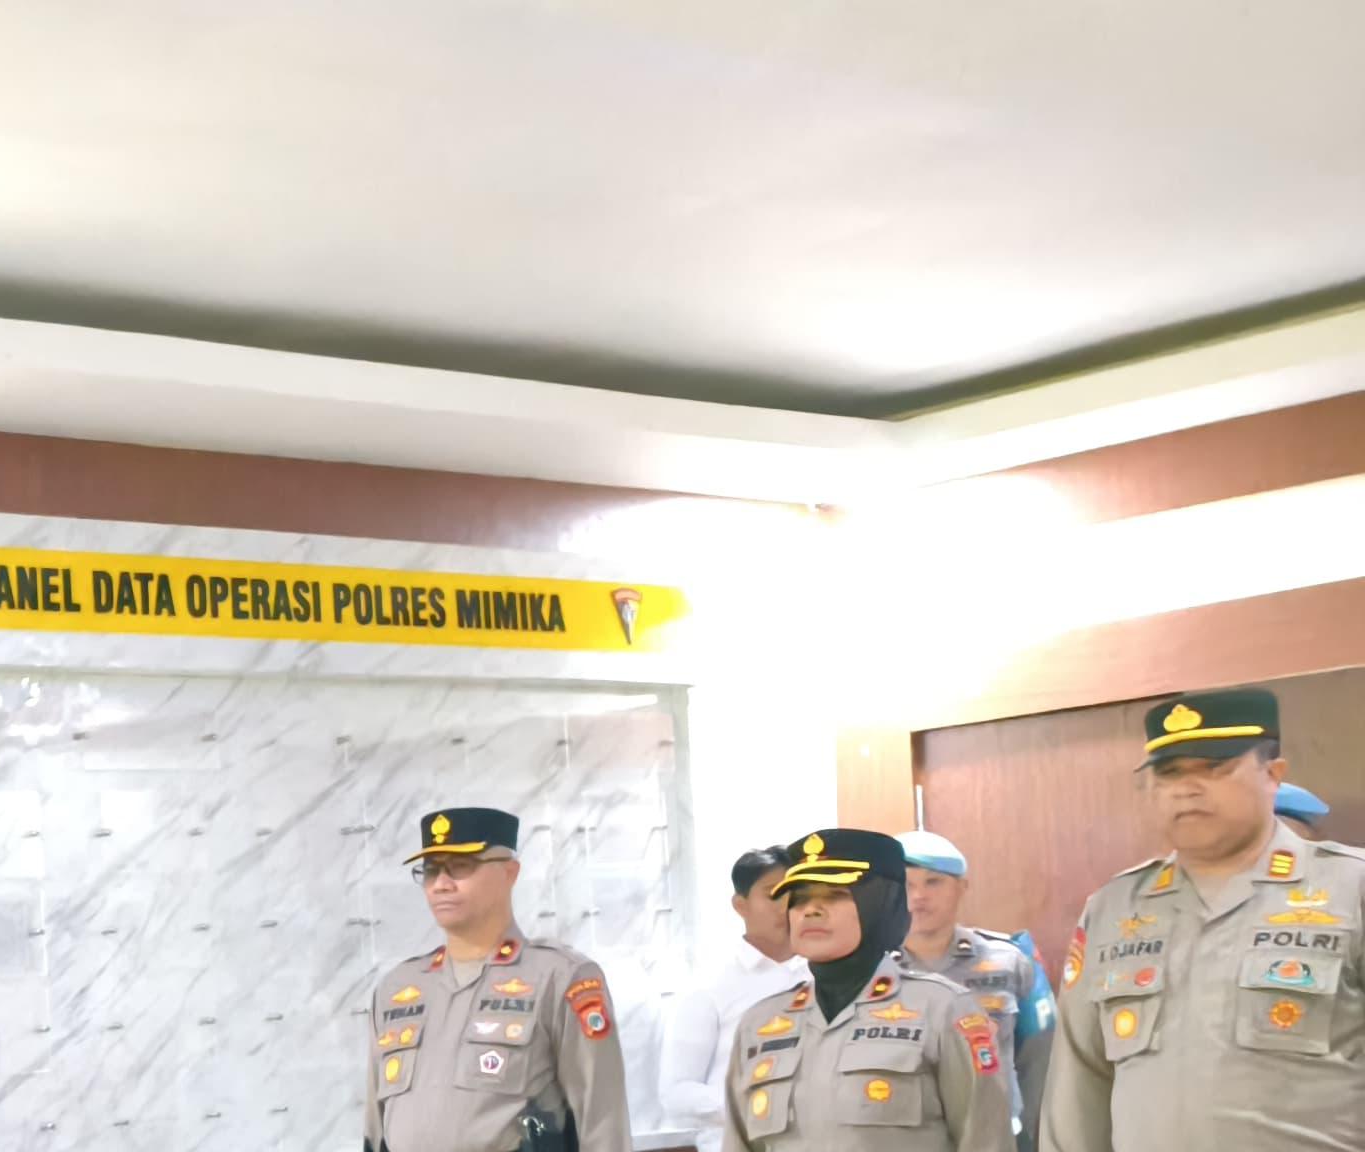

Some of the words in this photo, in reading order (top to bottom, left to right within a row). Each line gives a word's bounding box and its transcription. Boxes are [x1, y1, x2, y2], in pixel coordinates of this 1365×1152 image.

[91, 570, 177, 617] DATA
[185, 574, 323, 624] OPERASI
[332, 582, 447, 629] POLRES
[455, 589, 567, 633] MIMIKA
[1252, 931, 1340, 952] POLRI
[852, 1026, 924, 1042] POLRI
